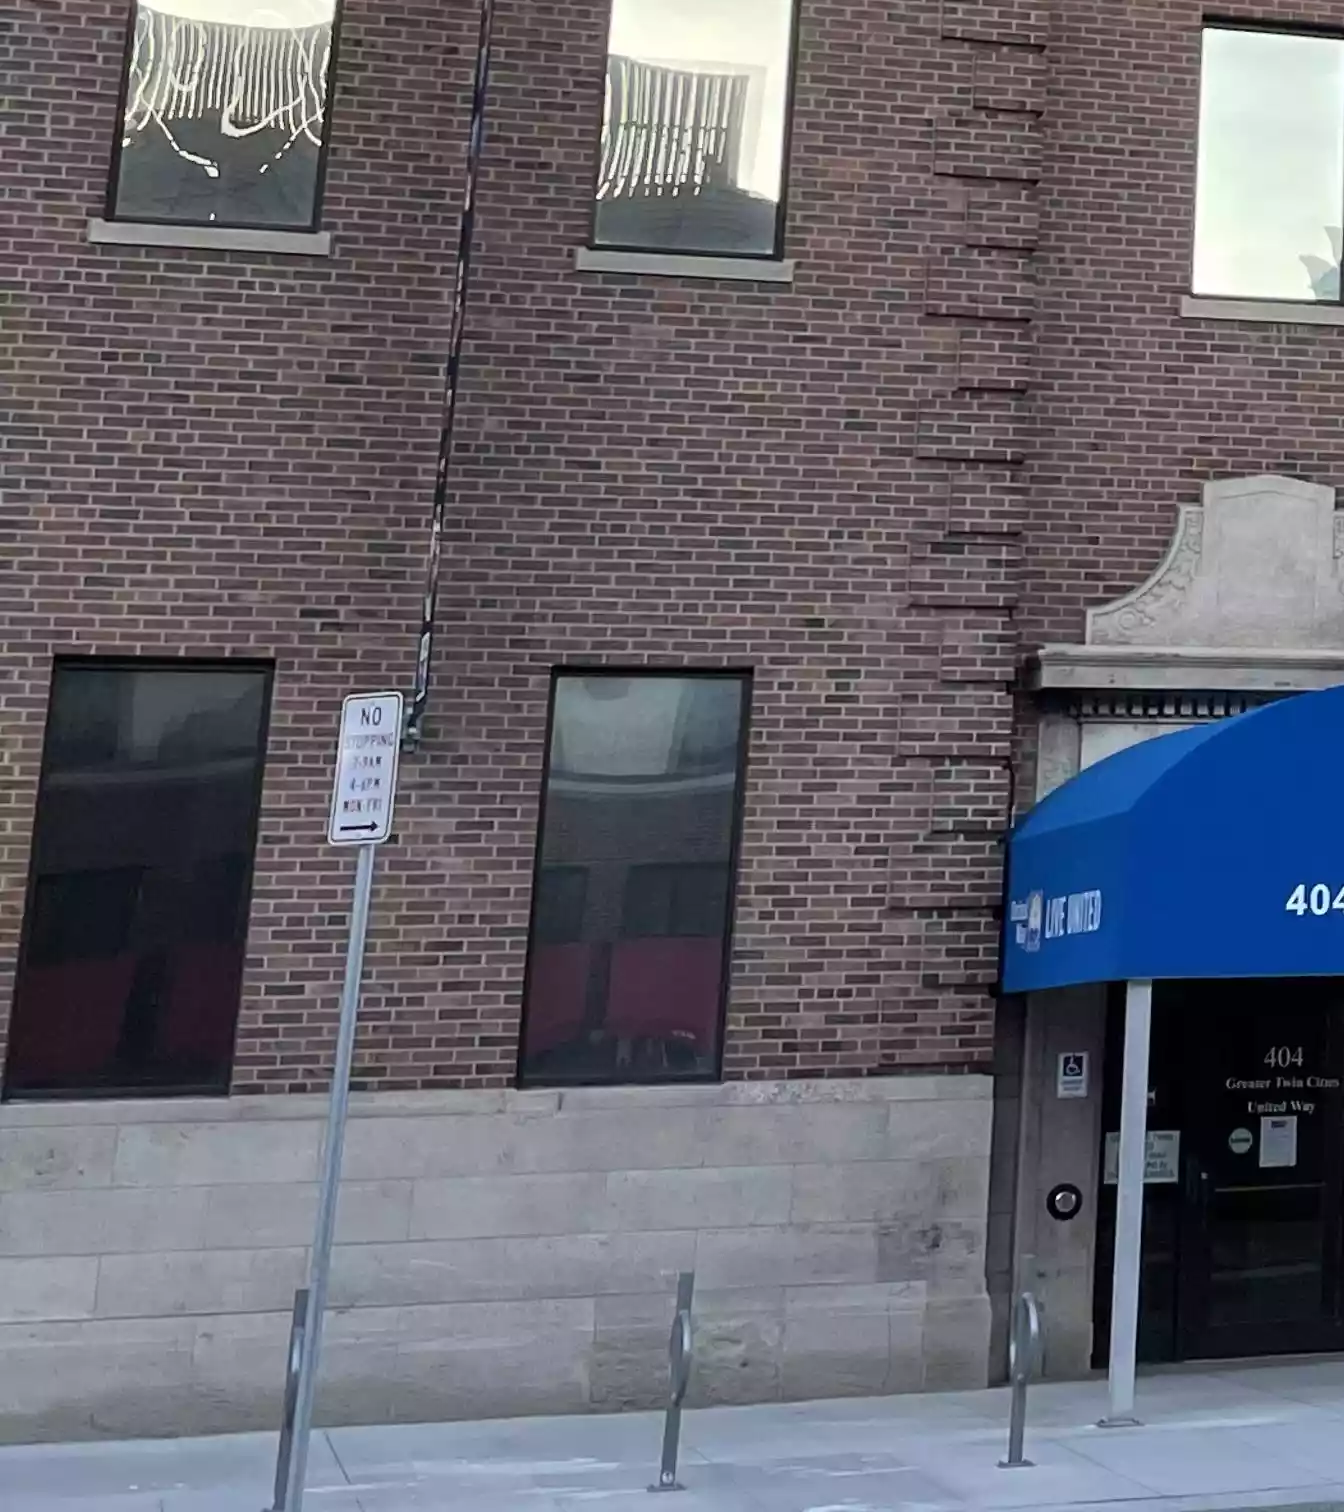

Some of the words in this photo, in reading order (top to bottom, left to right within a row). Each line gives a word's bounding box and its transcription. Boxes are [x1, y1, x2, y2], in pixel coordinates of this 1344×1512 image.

[360, 706, 382, 726] NO
[345, 733, 393, 749] STOPPING
[1263, 1046, 1304, 1068] 404
[1225, 1076, 1272, 1089] Greater
[1276, 1075, 1304, 1088] Twin
[1247, 1100, 1287, 1113] United
[1290, 1100, 1316, 1115] Way
